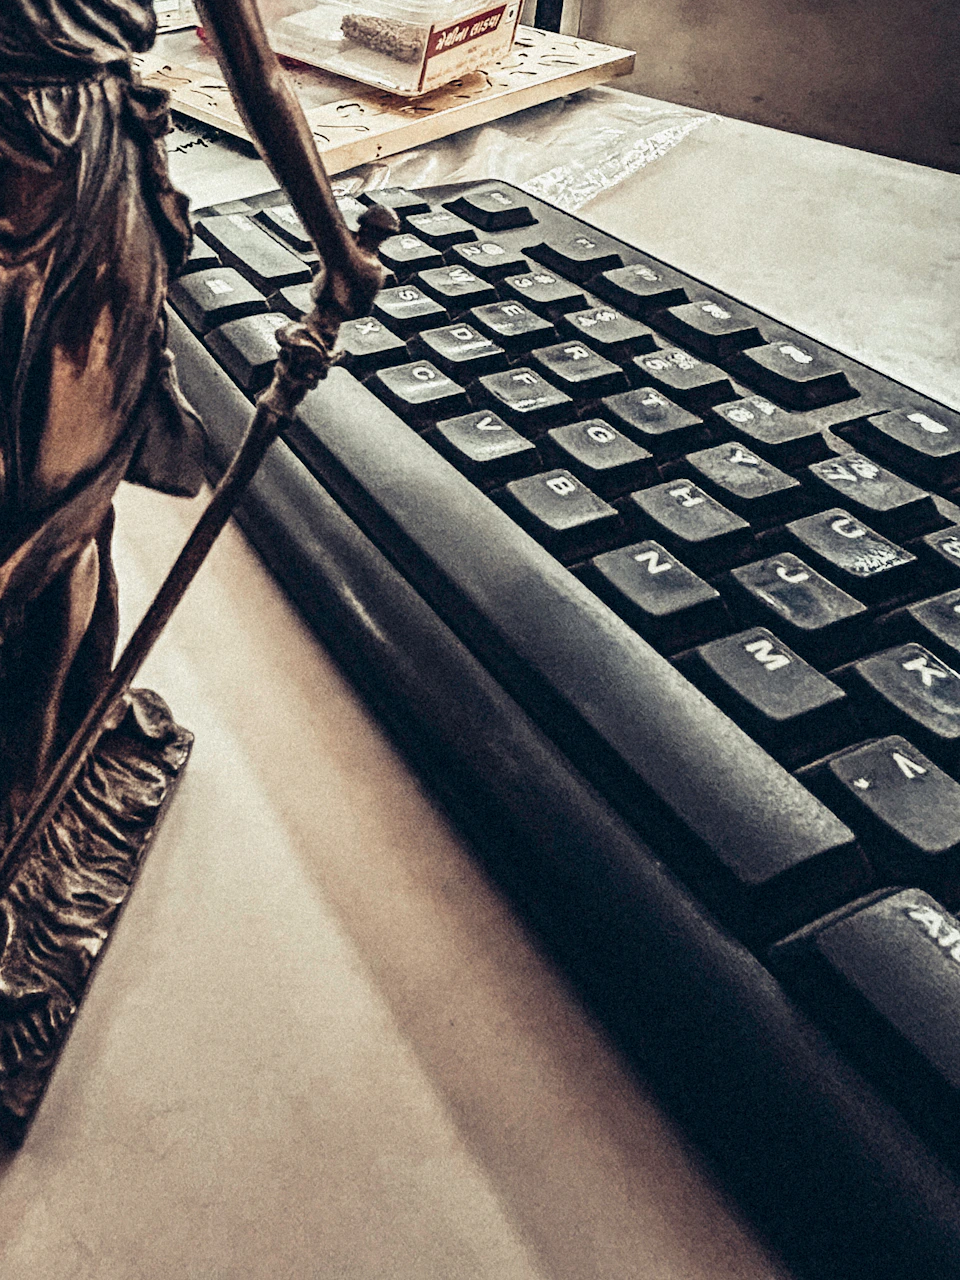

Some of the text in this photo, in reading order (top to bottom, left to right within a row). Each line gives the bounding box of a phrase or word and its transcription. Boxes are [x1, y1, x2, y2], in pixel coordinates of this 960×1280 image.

[448, 269, 475, 283] W
[399, 290, 418, 301] S
[500, 304, 525, 317] E
[355, 322, 381, 335] X
[450, 328, 474, 341] D
[564, 345, 589, 360] R
[412, 366, 435, 381] C
[512, 372, 538, 385] F
[640, 394, 666, 407] T
[476, 416, 502, 431] V
[586, 426, 616, 444] G
[729, 448, 760, 464] Y
[546, 476, 575, 497] B
[669, 487, 703, 508] H
[831, 519, 867, 538] U
[634, 551, 672, 574] N
[775, 566, 809, 583] J
[744, 639, 791, 671] M
[902, 658, 947, 687] K
